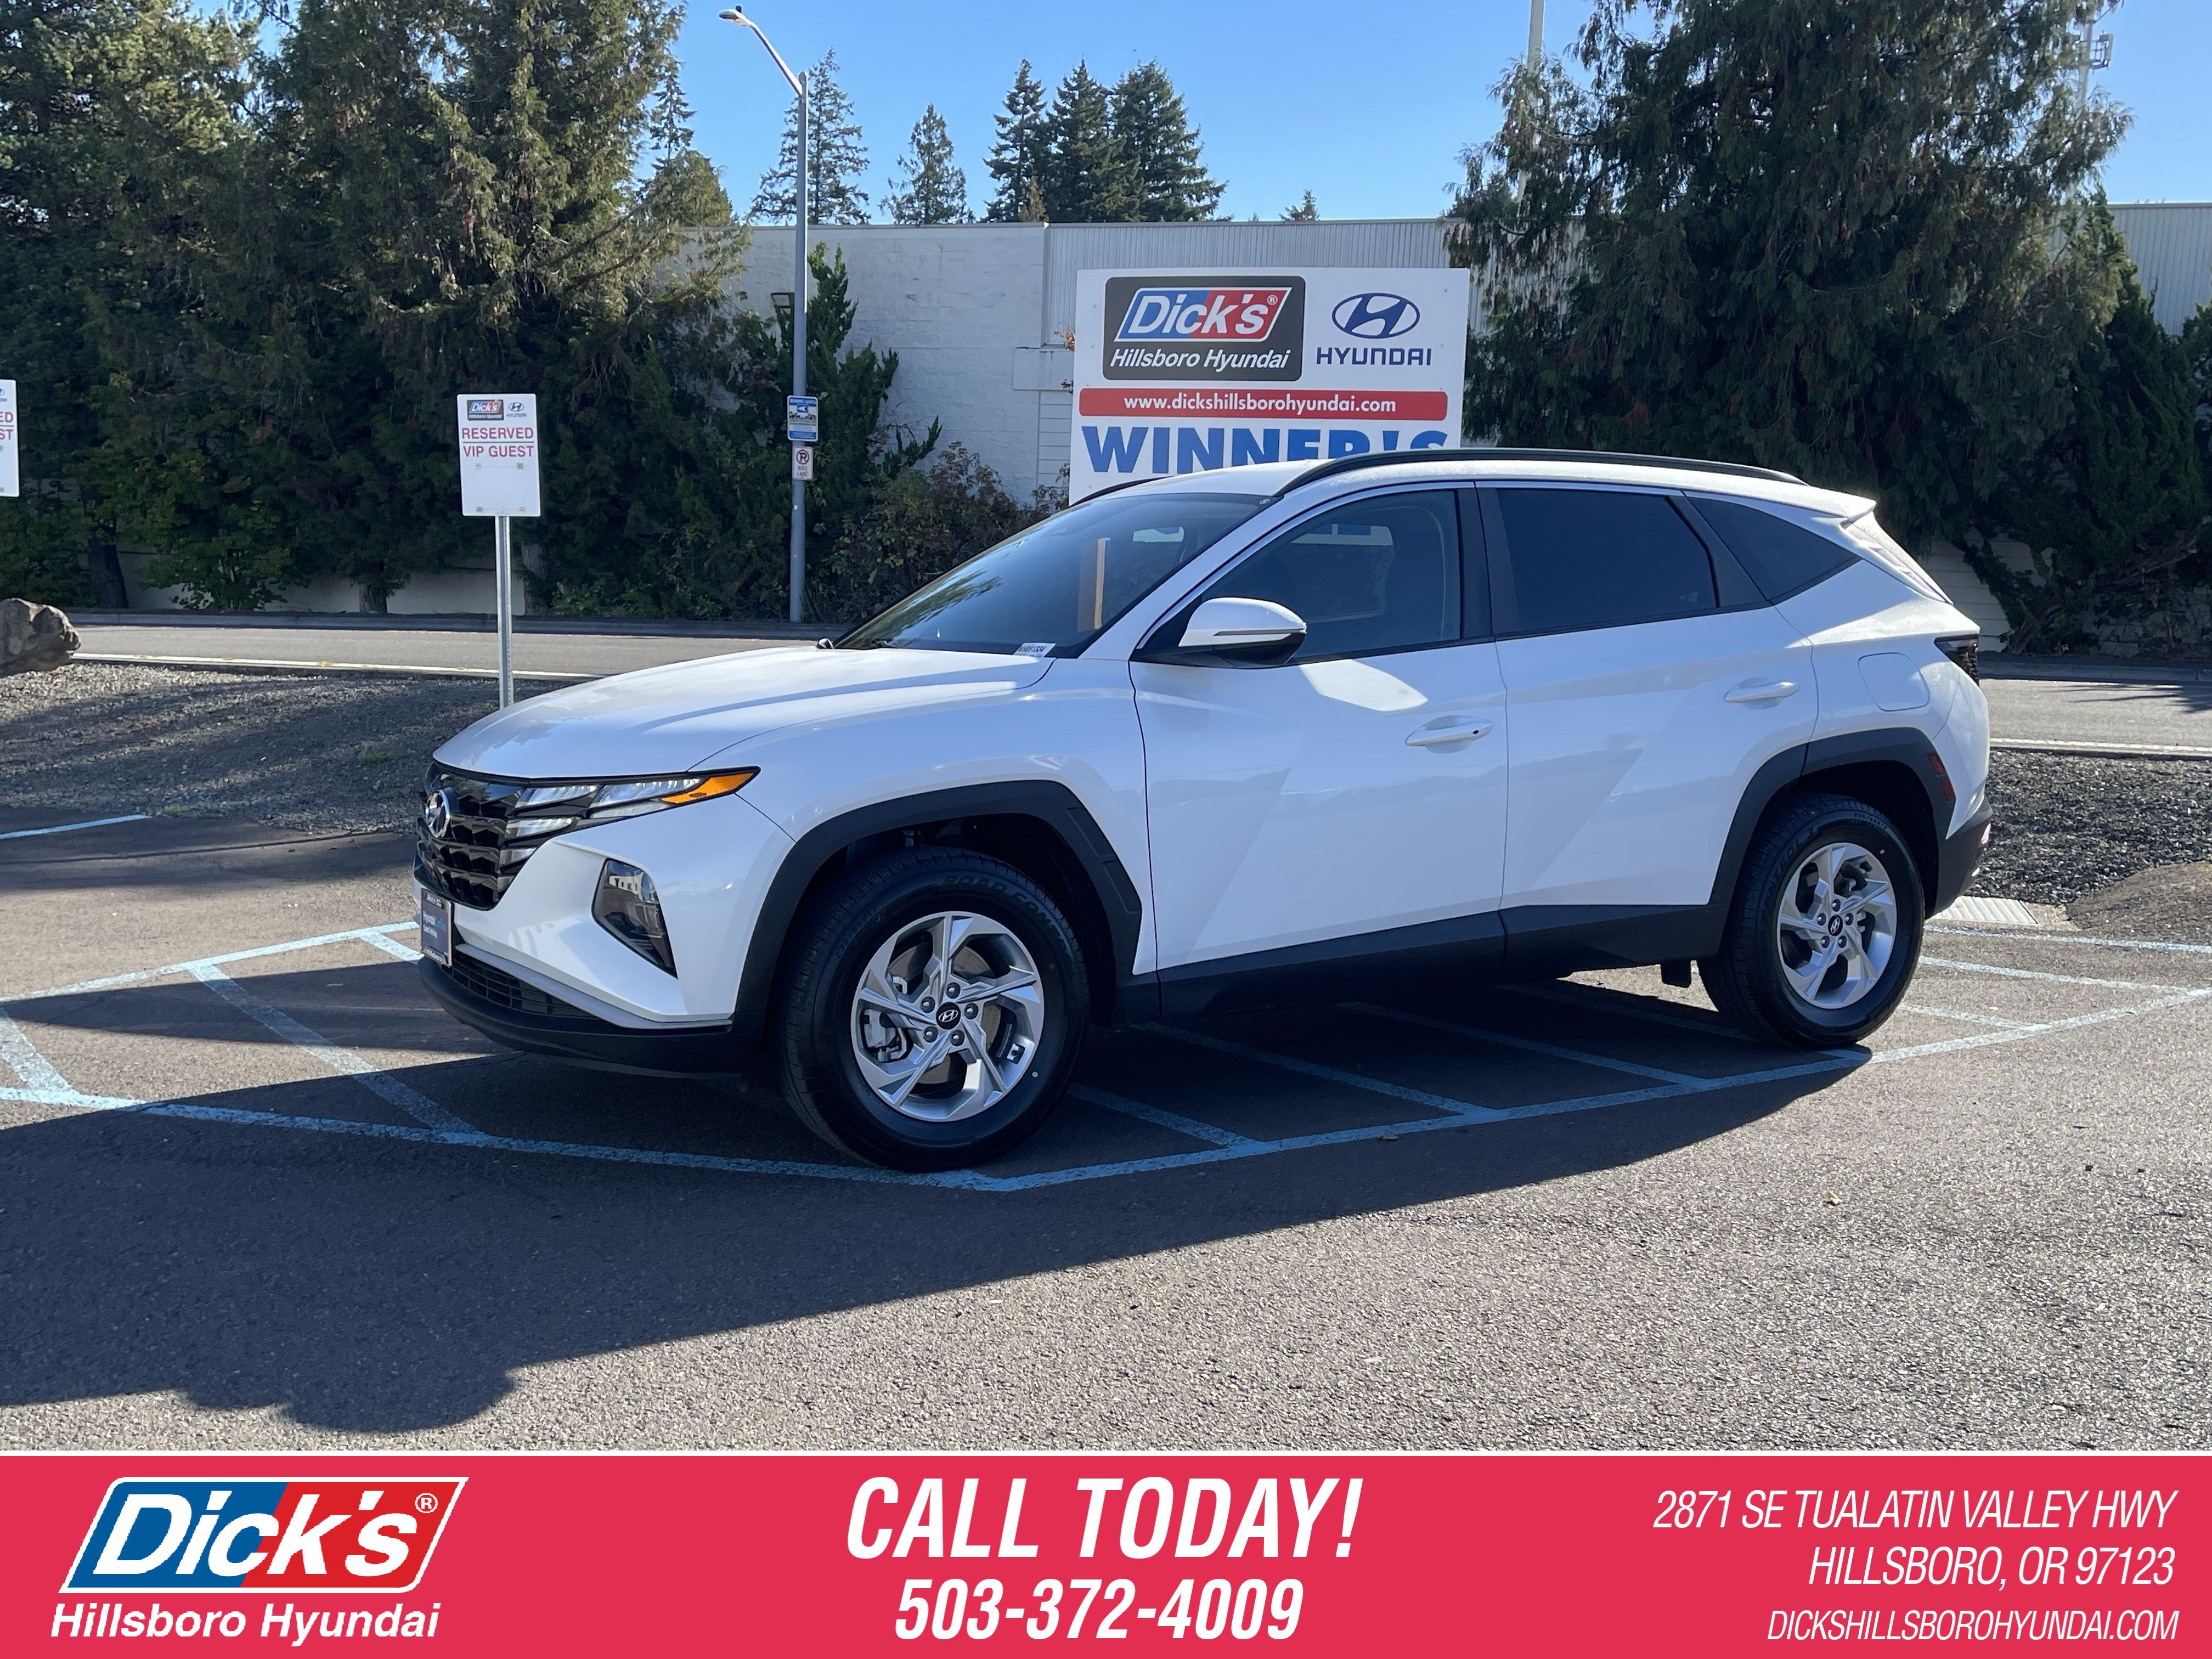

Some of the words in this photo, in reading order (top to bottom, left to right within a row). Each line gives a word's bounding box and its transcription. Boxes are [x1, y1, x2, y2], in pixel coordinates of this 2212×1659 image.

[1127, 294, 1268, 335] Dick's
[1110, 348, 1200, 368] Hillsboro
[1203, 349, 1291, 373] Hyundai
[1316, 347, 1431, 366] HYUNDAI
[472, 402, 498, 412] Dick's
[1124, 392, 1397, 415] www.dickshillsborohyundai.com
[461, 427, 534, 439] RESERVED
[463, 445, 484, 457] VIP
[488, 445, 534, 458] GUEST
